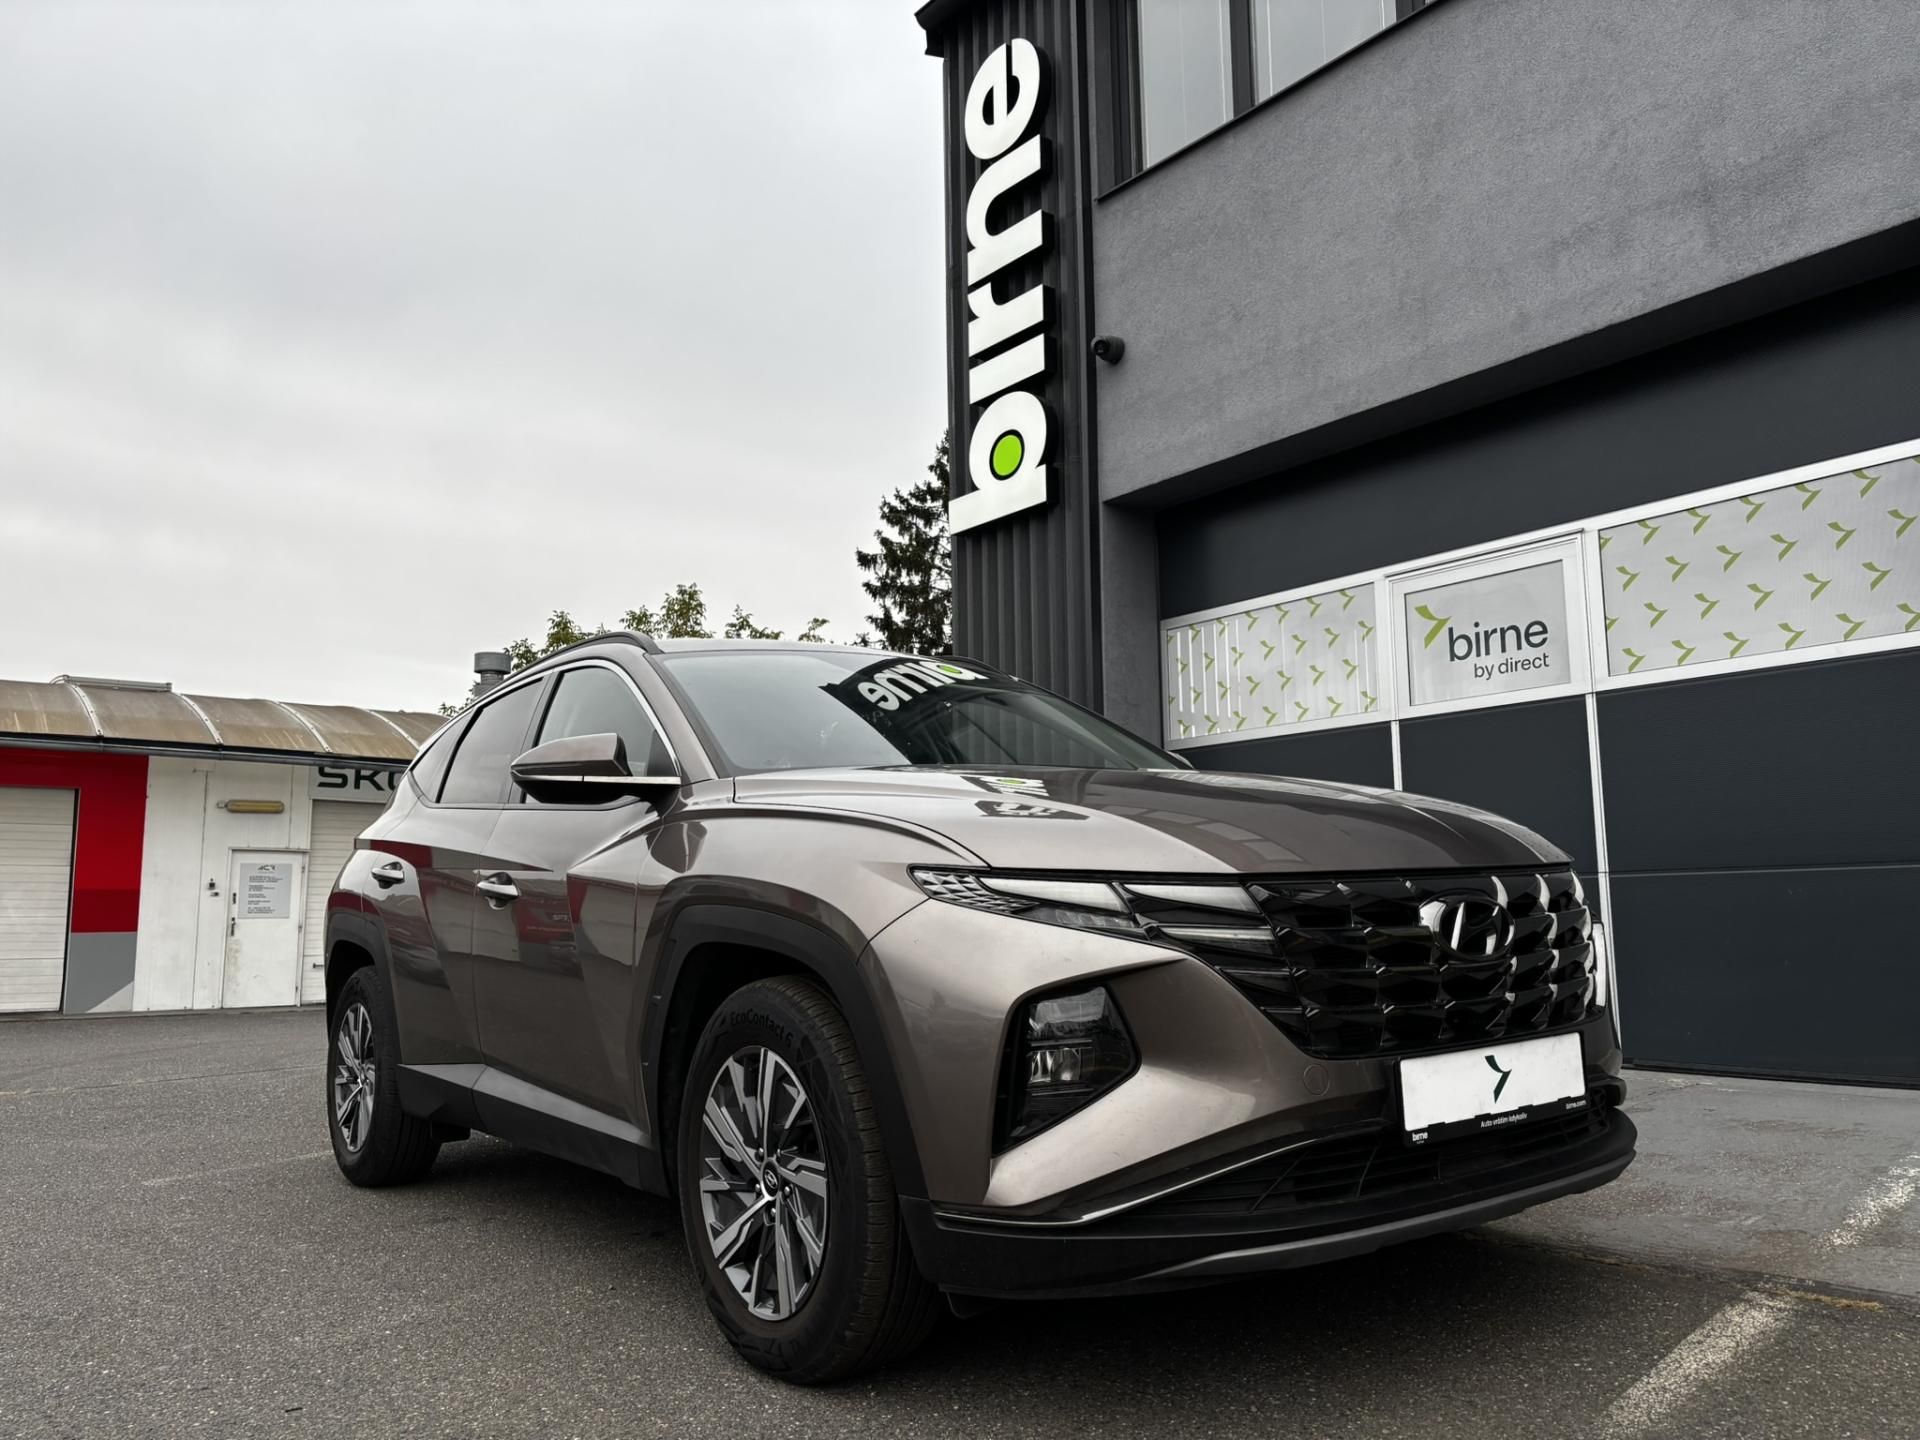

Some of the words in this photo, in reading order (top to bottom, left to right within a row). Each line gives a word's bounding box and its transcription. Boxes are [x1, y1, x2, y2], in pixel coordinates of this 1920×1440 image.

[948, 38, 1047, 535] birne
[1448, 620, 1549, 662] birne
[1474, 663, 1494, 680] by
[1498, 652, 1549, 674] direct
[730, 1008, 784, 1041] EcoContact
[784, 1032, 794, 1048] 6
[1480, 1120, 1492, 1128] Auto
